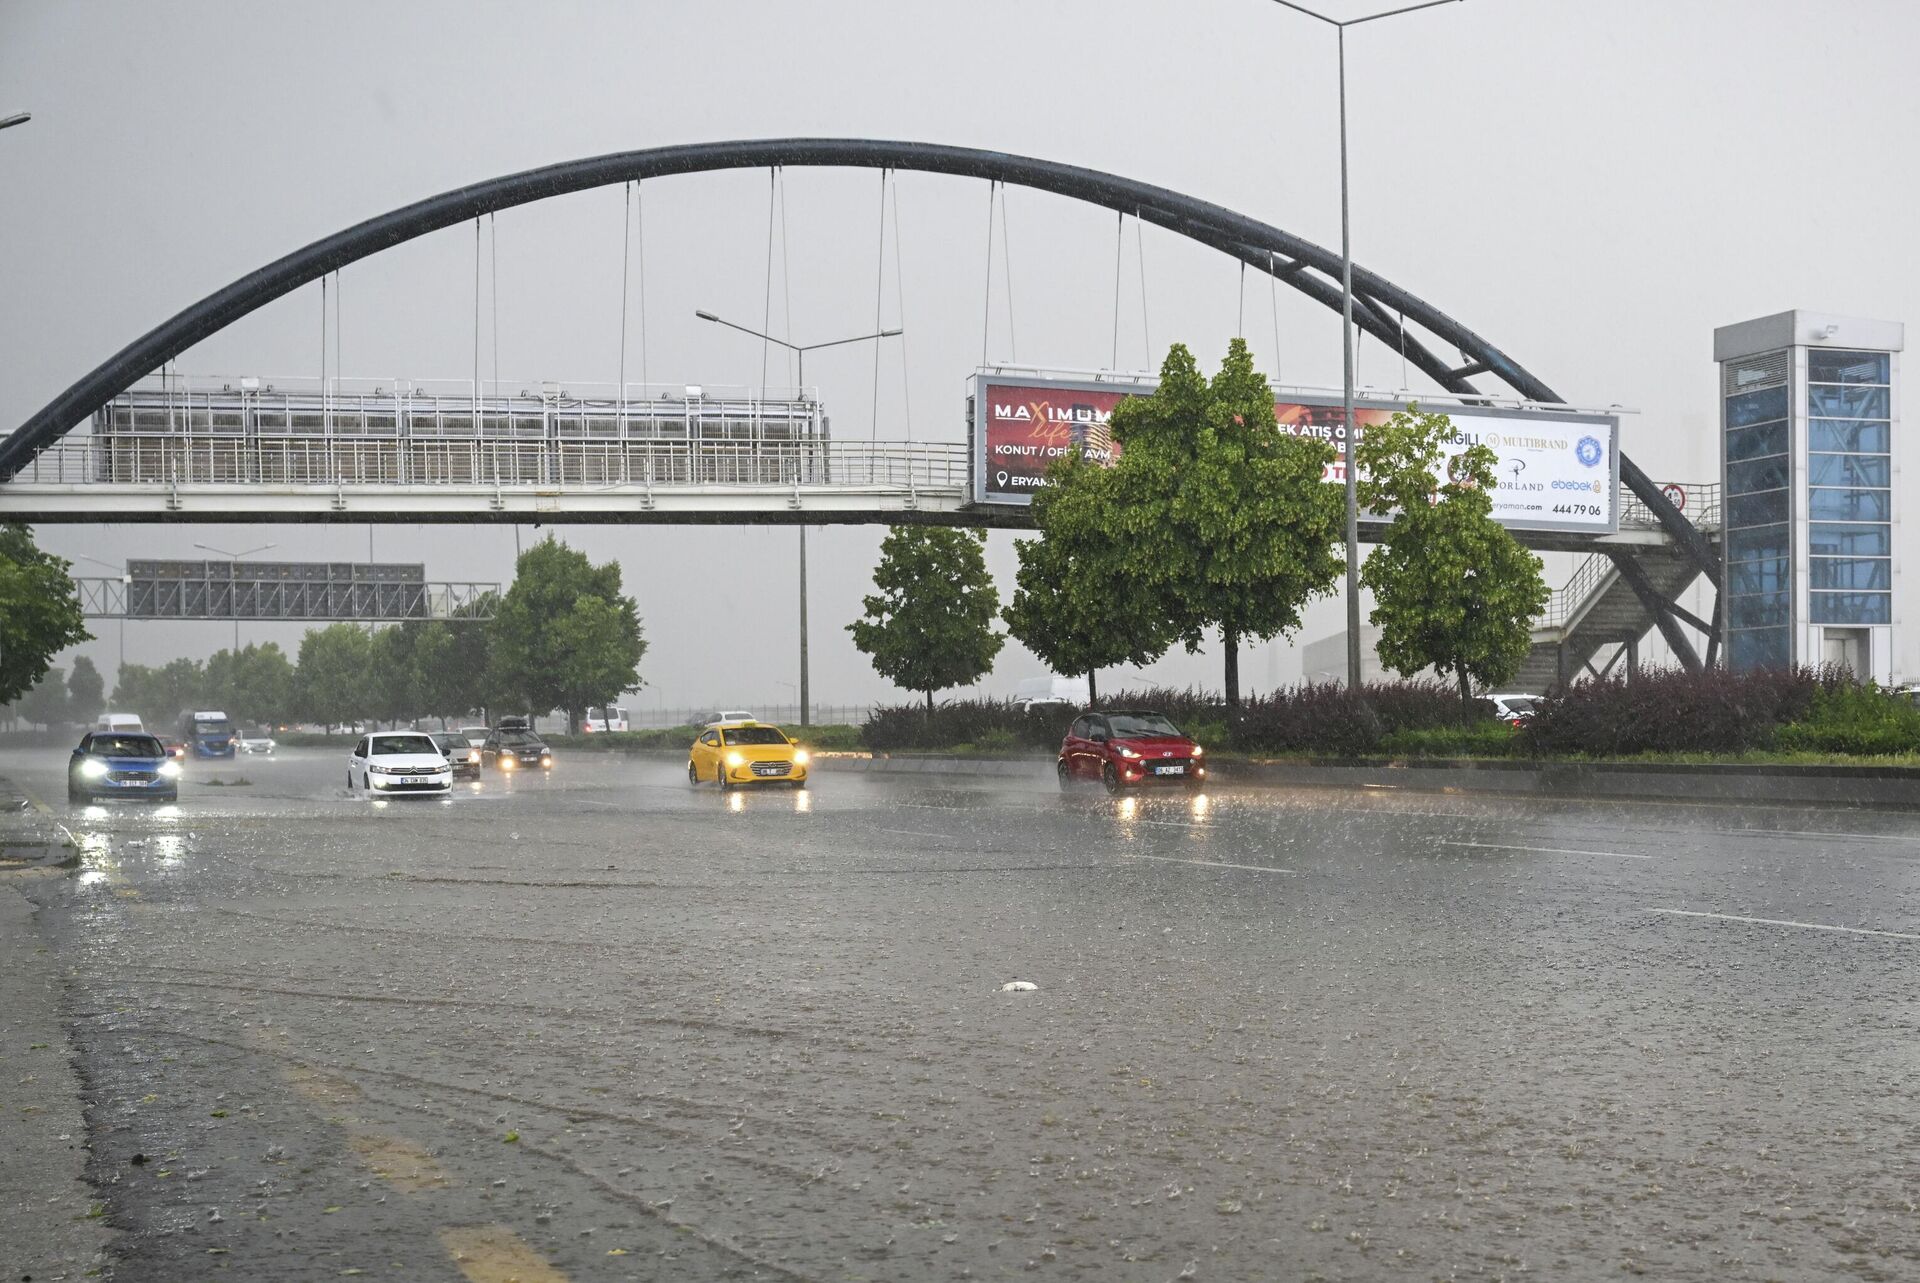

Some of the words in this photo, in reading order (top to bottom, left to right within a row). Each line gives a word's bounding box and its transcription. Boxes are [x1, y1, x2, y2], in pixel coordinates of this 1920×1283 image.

[995, 401, 1111, 424] MAXIMUM
[1028, 421, 1074, 446] life
[1278, 424, 1298, 436] EK
[1300, 425, 1332, 441] ATIŞ
[1503, 436, 1568, 450] MULTIBRAND
[995, 445, 1038, 456] KONUT
[1085, 449, 1110, 459] AVM
[1499, 481, 1544, 491] ORLAND
[1551, 480, 1592, 491] ebebek
[1492, 503, 1543, 511] eryaman.com
[1552, 504, 1572, 514] 444
[1573, 505, 1586, 515] 79
[1588, 505, 1601, 516] 06
